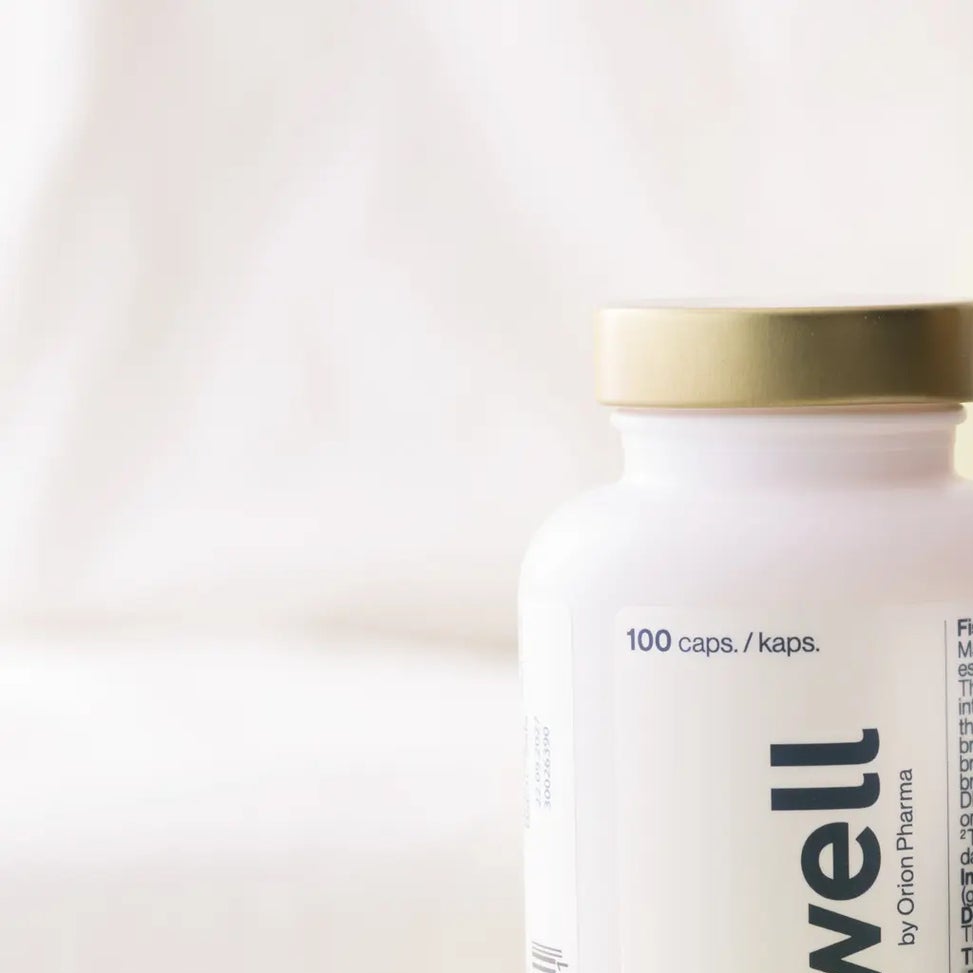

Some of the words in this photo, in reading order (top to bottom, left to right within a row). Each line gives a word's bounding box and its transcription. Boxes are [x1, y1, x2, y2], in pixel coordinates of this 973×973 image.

[626, 628, 672, 651] 100
[678, 634, 738, 657] caps.
[743, 632, 753, 653] /
[758, 632, 820, 657] kaps.
[896, 768, 914, 852] Pharma
[896, 856, 915, 916] Orion
[897, 921, 919, 947] by
